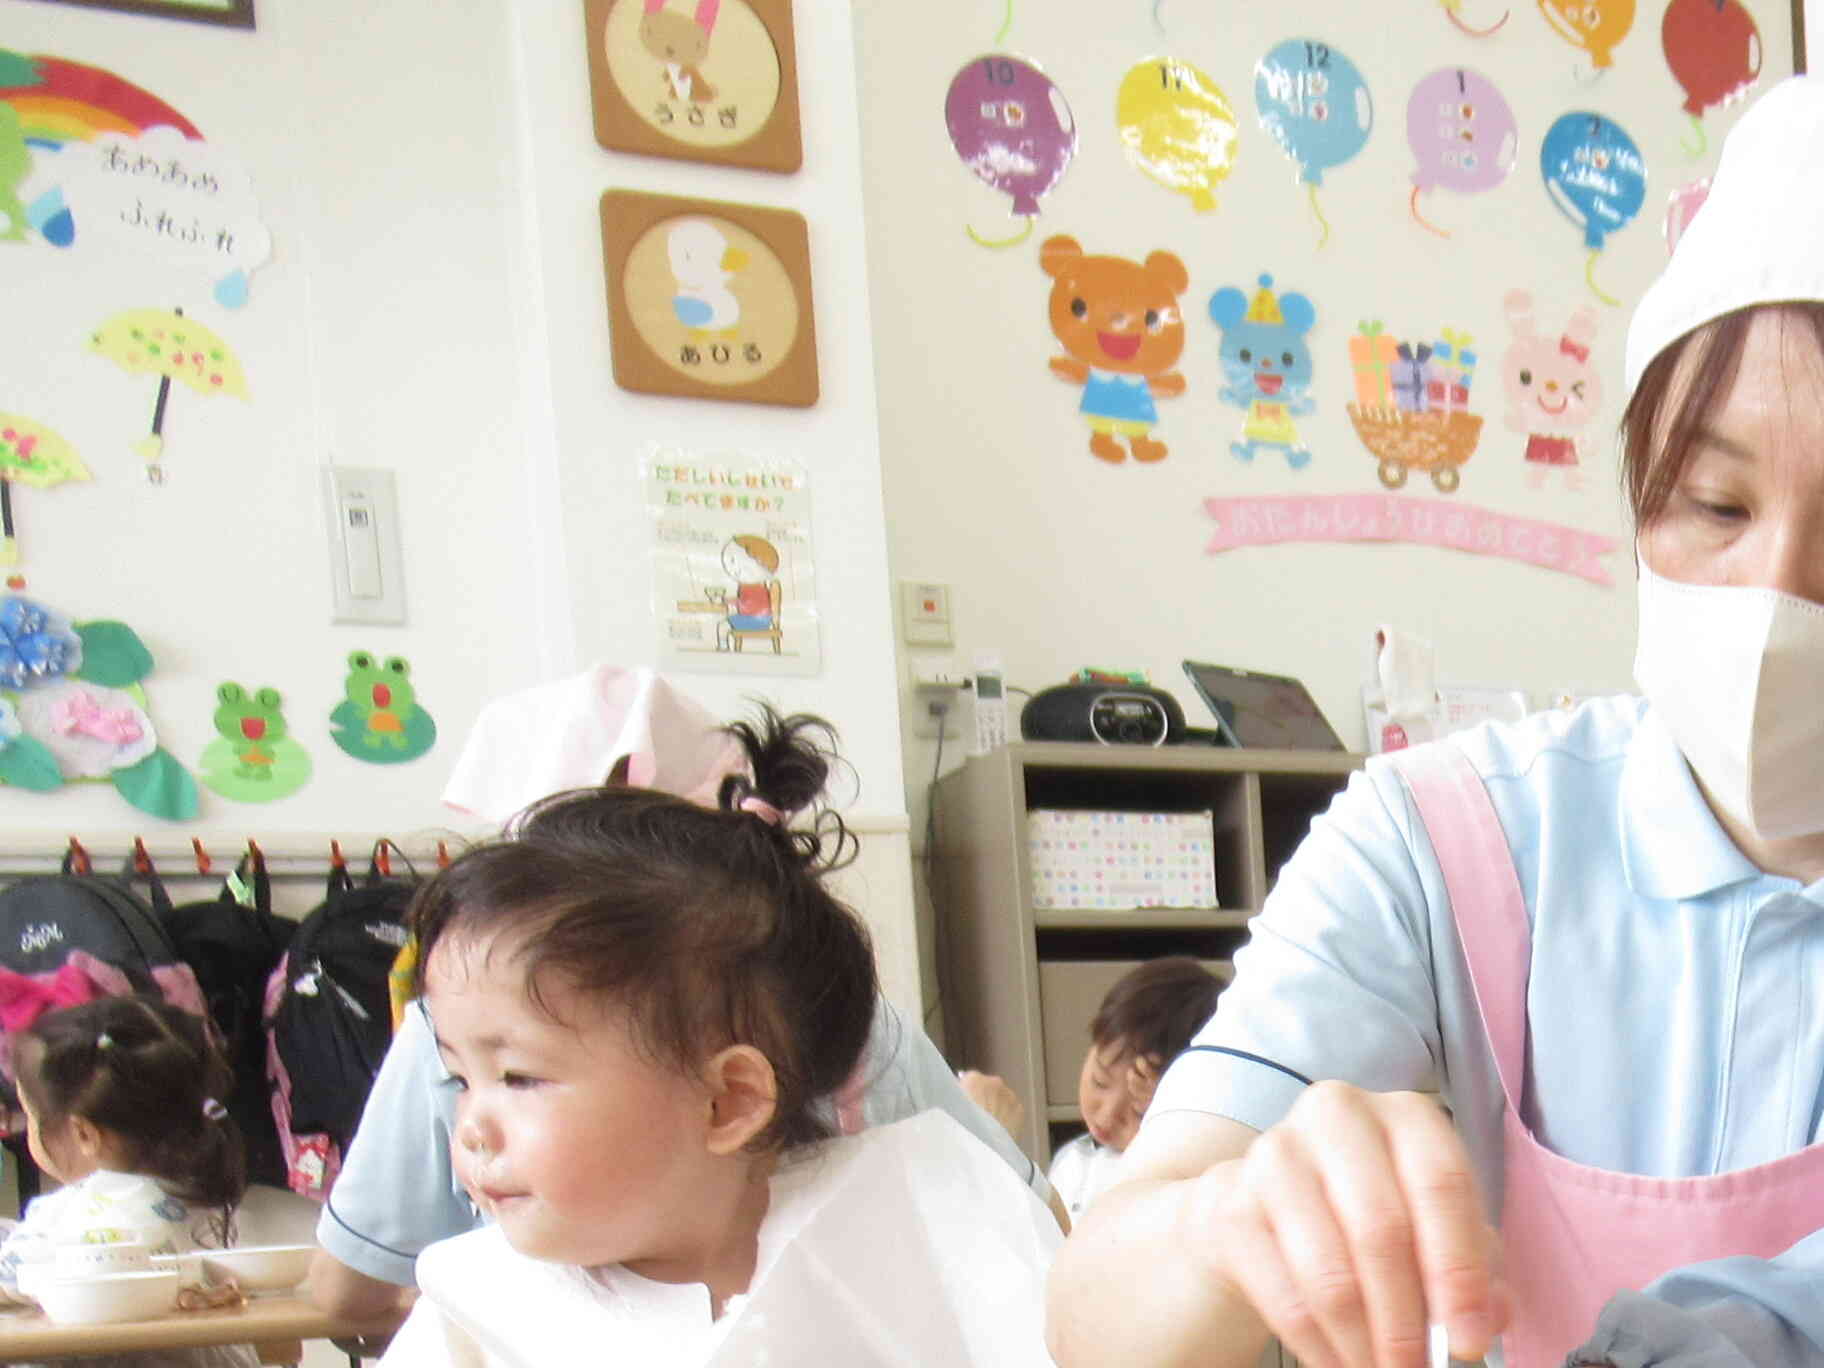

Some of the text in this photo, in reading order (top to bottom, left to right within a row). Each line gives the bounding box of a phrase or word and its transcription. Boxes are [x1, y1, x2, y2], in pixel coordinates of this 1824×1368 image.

[1304, 41, 1330, 70] 12
[655, 103, 738, 128] うさぎ
[680, 343, 762, 365] あひる
